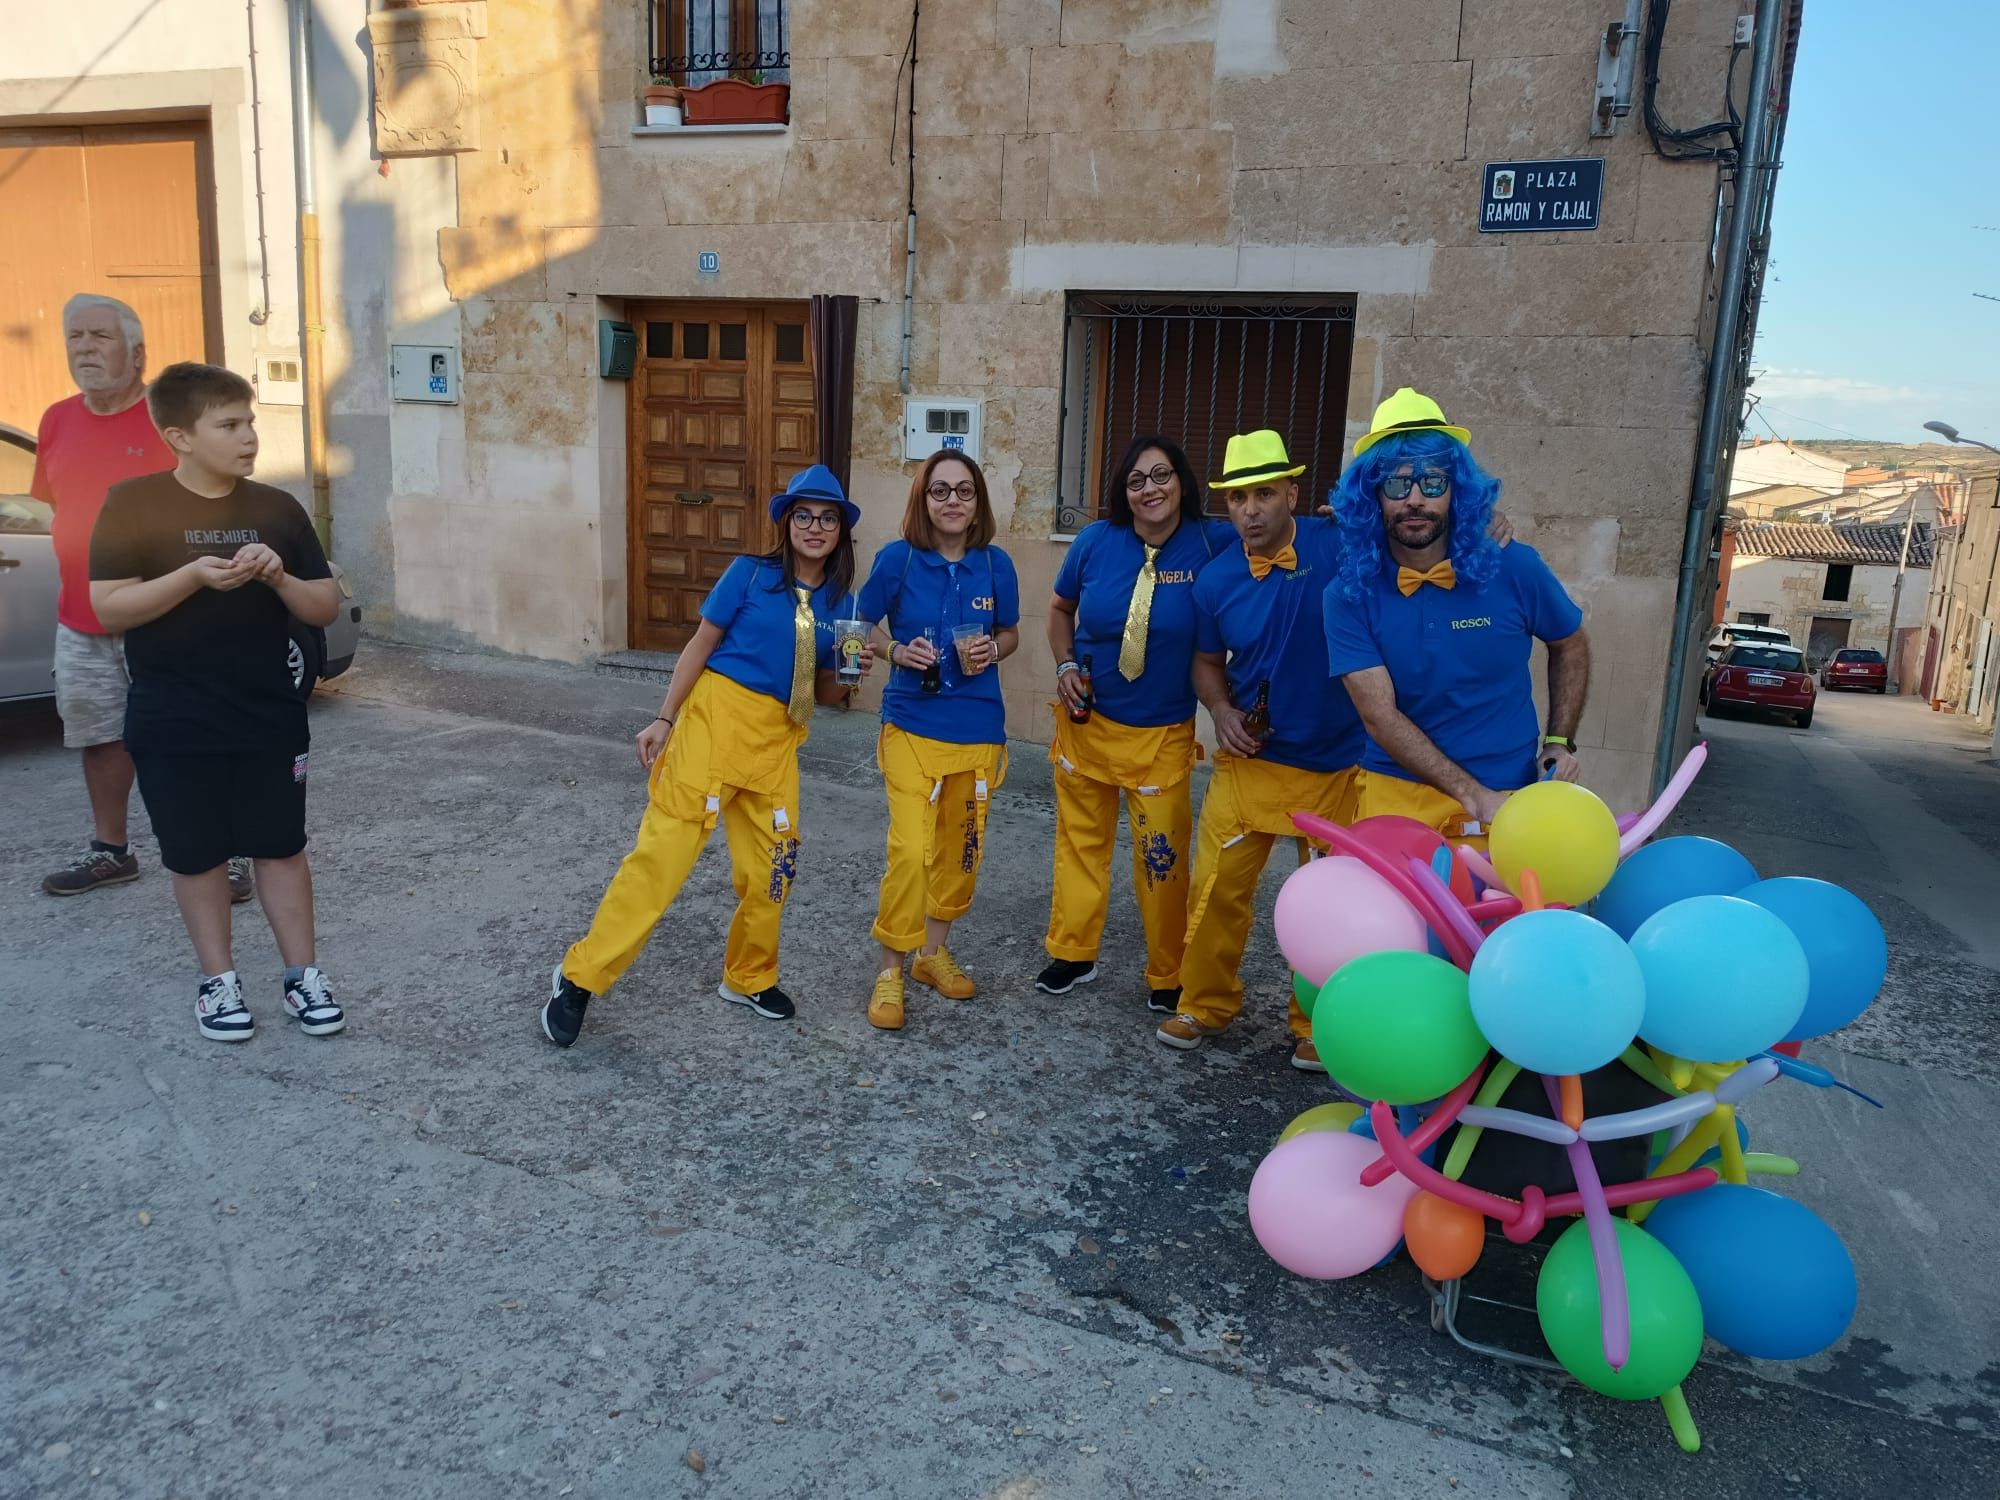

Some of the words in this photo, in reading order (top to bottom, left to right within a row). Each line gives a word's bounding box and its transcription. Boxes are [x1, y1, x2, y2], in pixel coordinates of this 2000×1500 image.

[1525, 171, 1577, 188] PLAZA
[1486, 201, 1531, 222] RAMON
[1538, 200, 1547, 221] Y
[1552, 200, 1593, 221] CAJAL
[703, 255, 715, 269] 10
[184, 528, 260, 544] REMEMBER
[971, 596, 995, 611] CH
